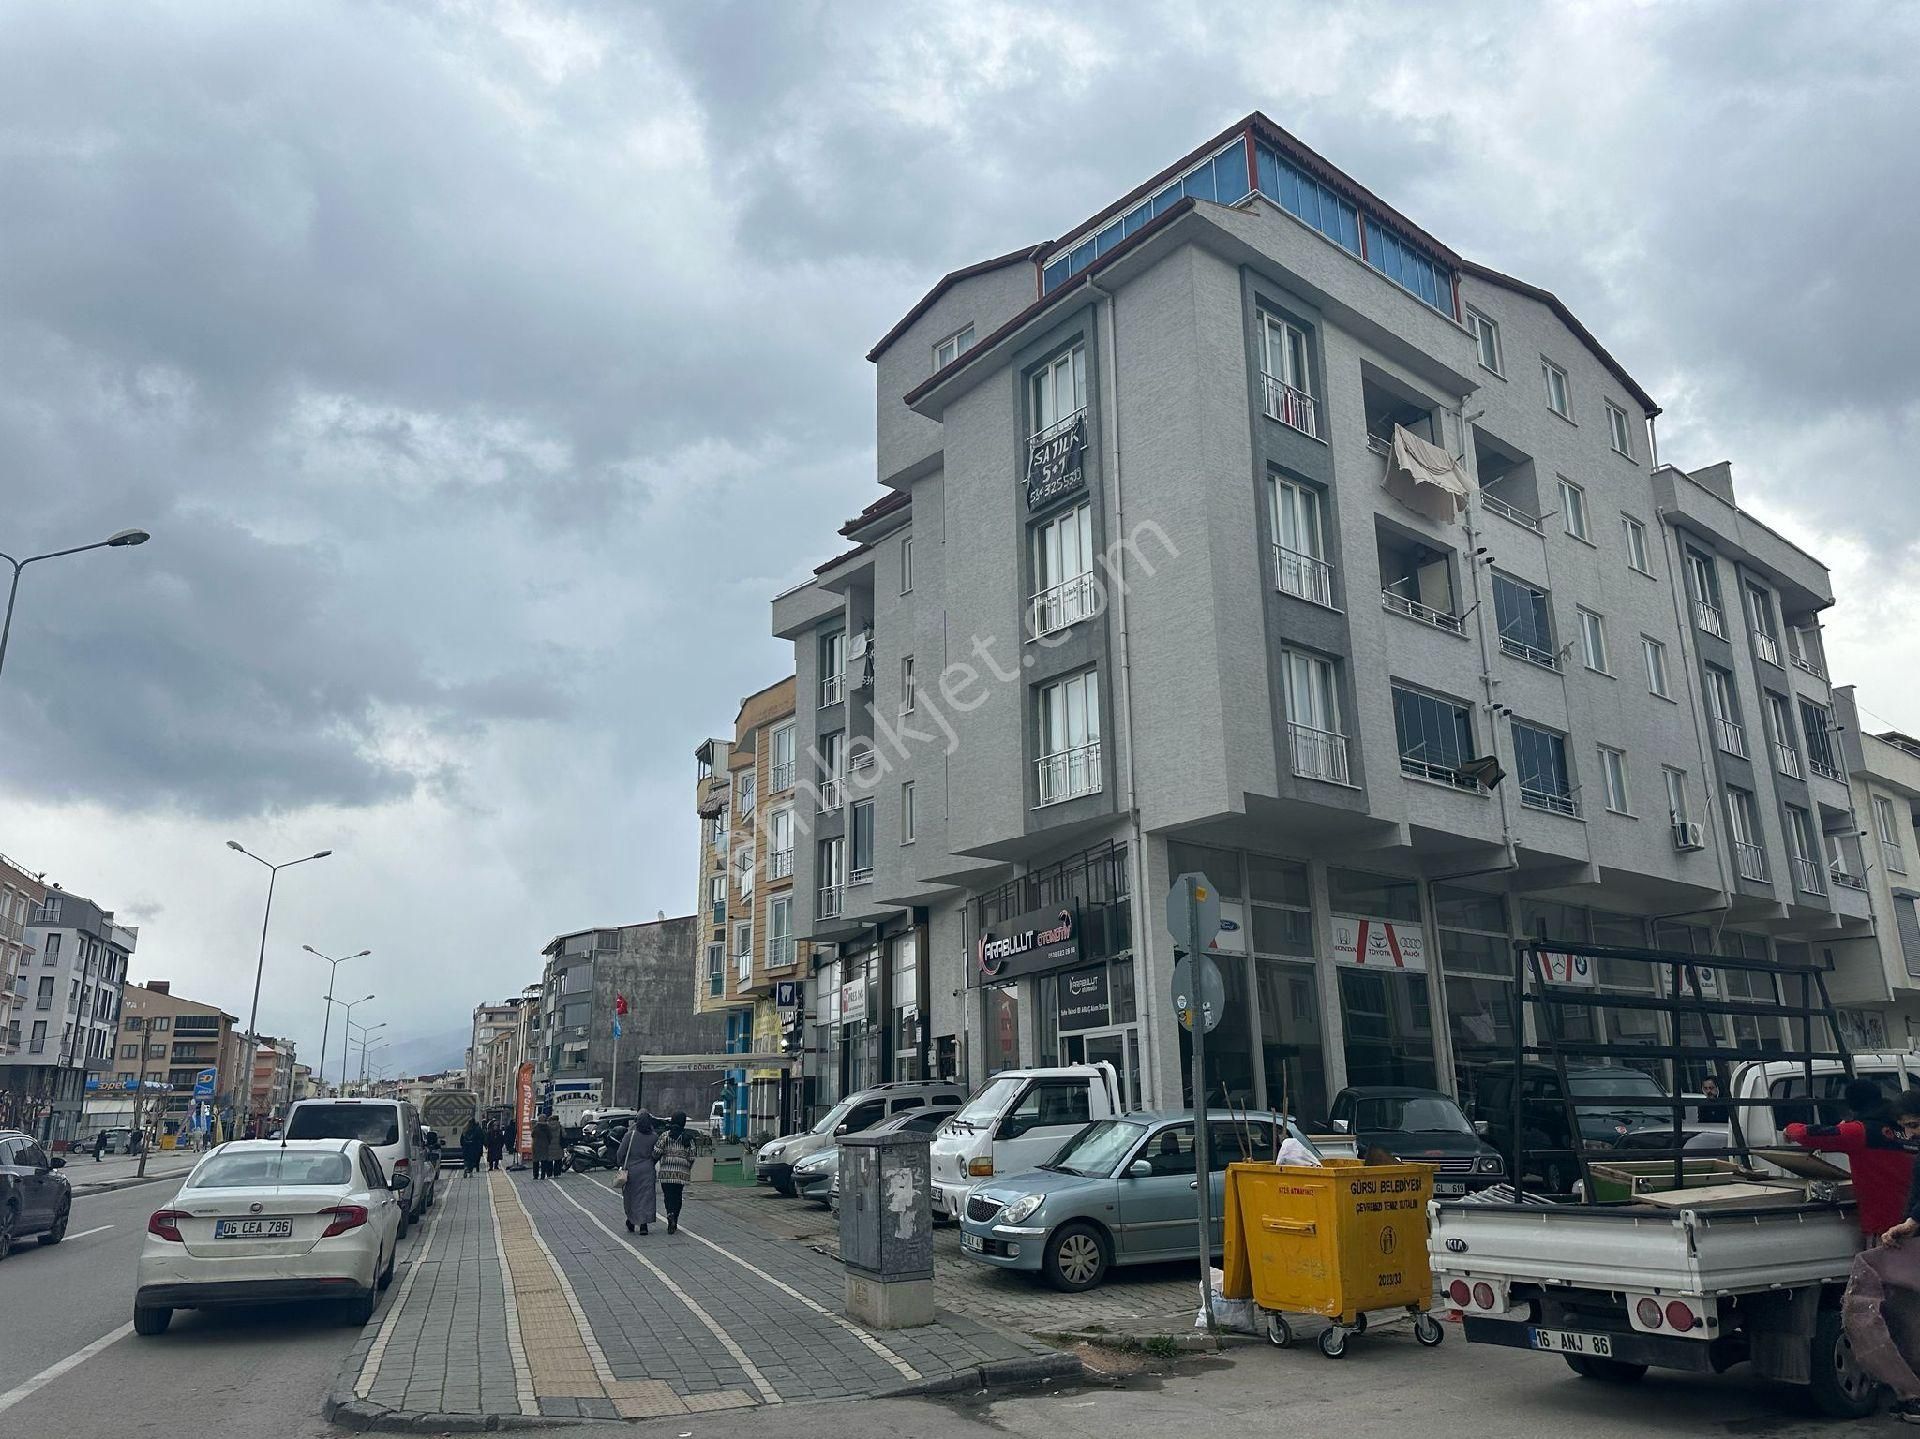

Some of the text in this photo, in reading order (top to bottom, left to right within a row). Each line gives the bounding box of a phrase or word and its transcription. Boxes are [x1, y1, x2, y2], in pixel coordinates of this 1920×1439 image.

[1369, 948, 1391, 957] TOYOTA
[223, 1221, 289, 1234] 06 CEA 786
[1447, 1239, 1464, 1251] KIA
[1537, 1331, 1608, 1354] 16 ANJ 86
